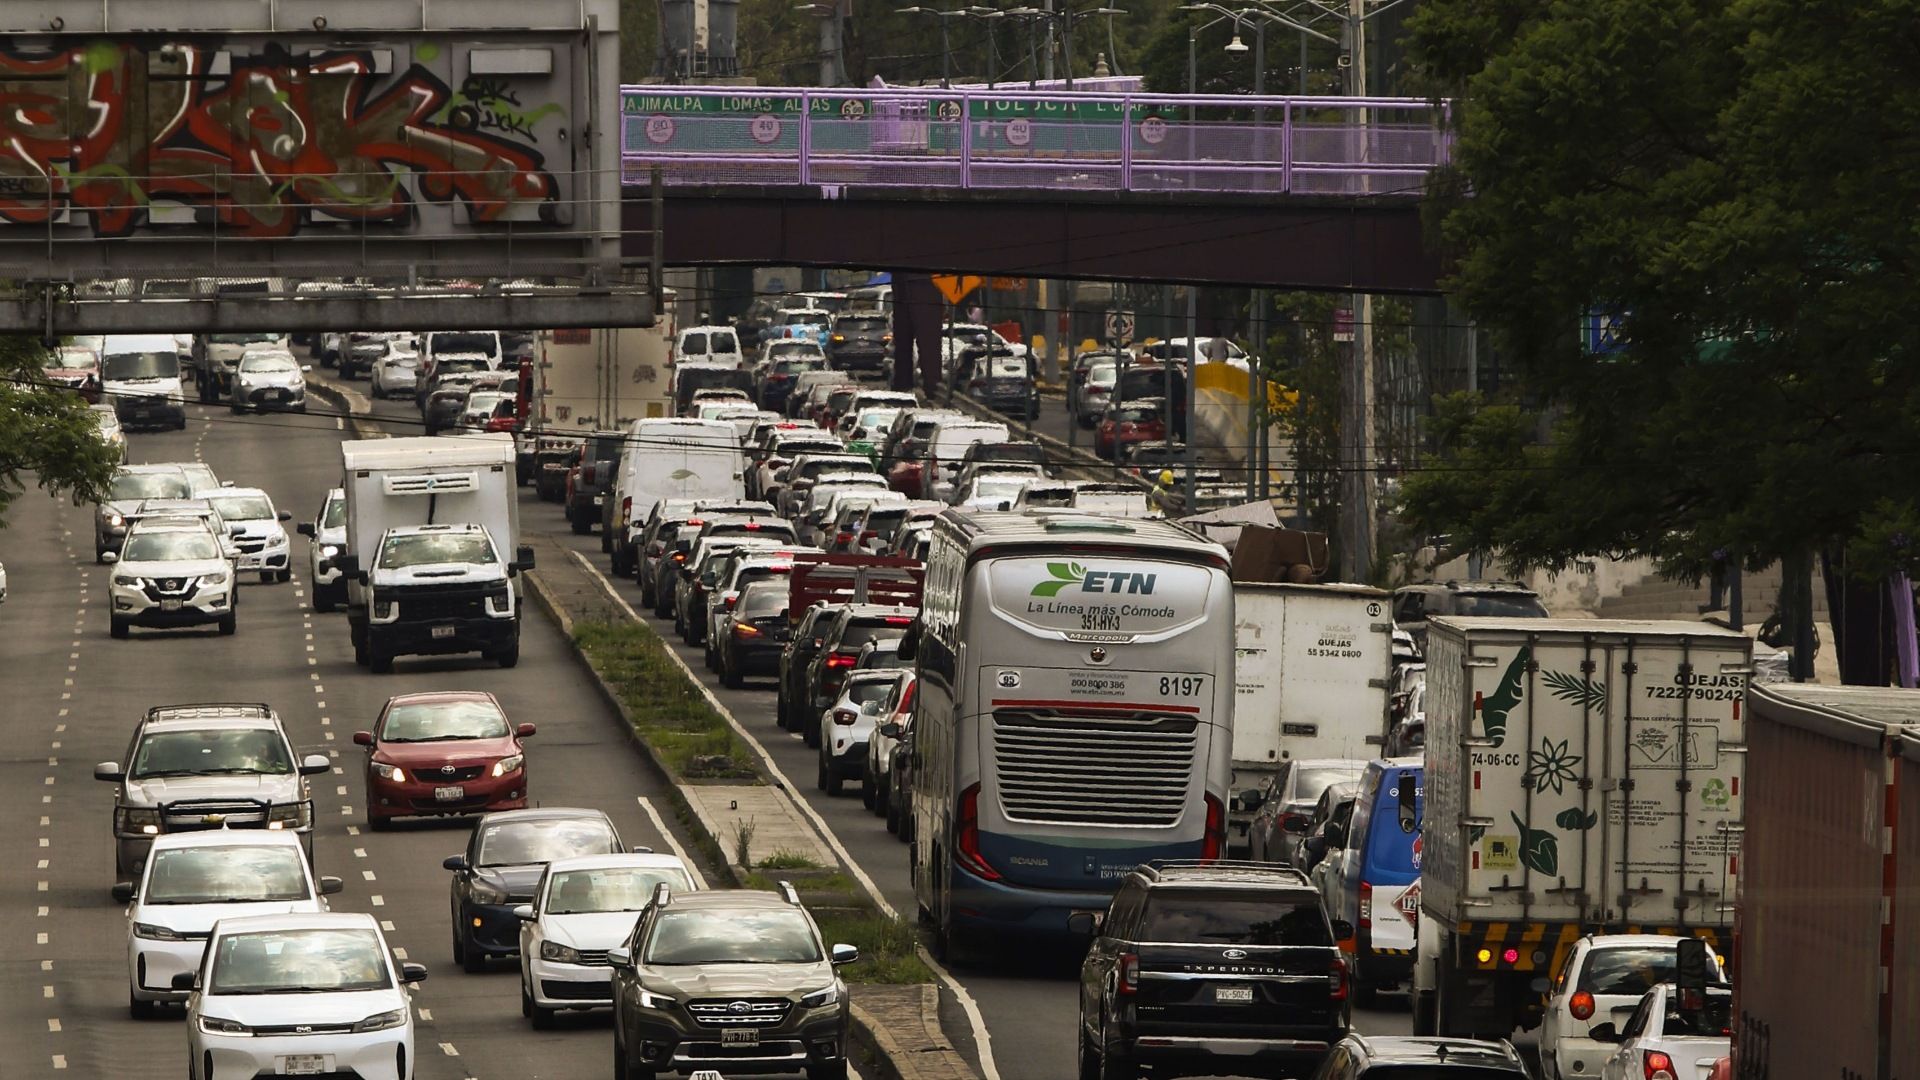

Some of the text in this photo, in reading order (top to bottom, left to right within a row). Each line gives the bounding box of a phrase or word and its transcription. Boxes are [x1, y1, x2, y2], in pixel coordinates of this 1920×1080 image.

[721, 97, 772, 111] LOMAS
[784, 98, 831, 111] ALAS
[759, 119, 774, 131] 40
[1081, 571, 1157, 595] ETN
[1027, 602, 1175, 618] La Línea más Cómoda
[1081, 614, 1120, 631] 351-HY-3
[1069, 633, 1129, 641] Marcopolo
[1318, 639, 1352, 648] QUEJAS
[1307, 648, 1318, 656] 55
[1319, 649, 1339, 657] 5342
[1071, 679, 1087, 687] 800
[1109, 681, 1125, 689] 386
[1159, 676, 1204, 697] 8197
[1674, 674, 1745, 688] QUEJAS:
[1646, 686, 1744, 702] 7222790242
[1472, 753, 1520, 766] 74-06-CC
[1183, 964, 1285, 974] EXPEDITION
